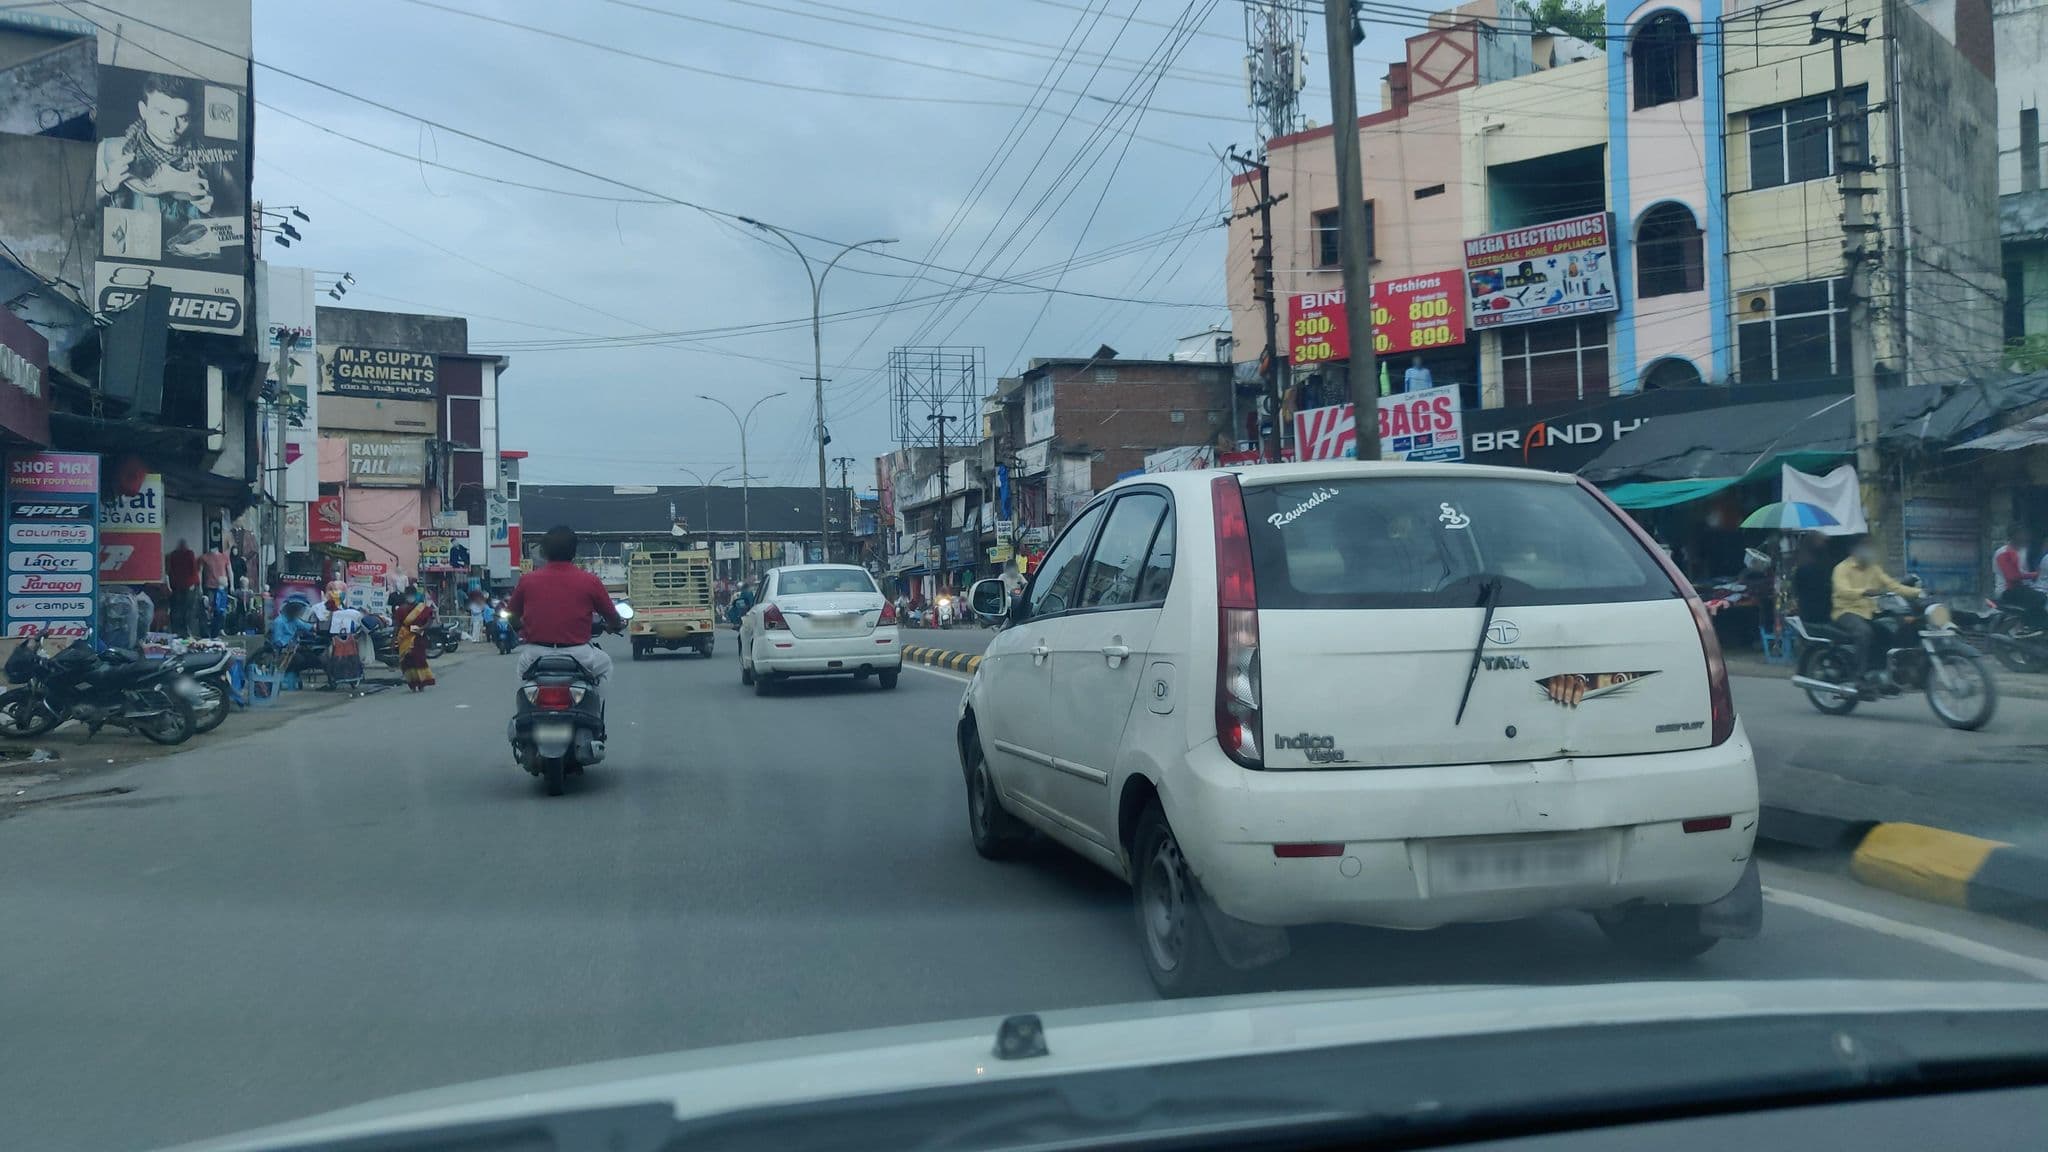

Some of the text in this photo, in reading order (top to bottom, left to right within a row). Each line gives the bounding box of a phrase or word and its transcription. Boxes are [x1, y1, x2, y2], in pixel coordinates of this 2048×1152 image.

[1466, 217, 1602, 256] MEGA ELECTRONICS
[1469, 237, 1603, 267] ELECTRICALS HOME APPLIANCES
[214, 287, 230, 295] USA
[1388, 277, 1440, 296] Fashions
[1409, 298, 1457, 321] 800/-
[1295, 317, 1336, 337] 300/-
[1410, 325, 1457, 347] 800/-
[340, 348, 434, 368] M.P. GUPTA
[1295, 342, 1337, 362] 300/-
[338, 363, 435, 383] GARMENTS
[1378, 396, 1453, 440] BAGS
[1472, 418, 1650, 465] BRAND H
[13, 461, 93, 475] SHOE MAX
[43, 478, 66, 486] FOOT
[16, 504, 88, 517] sparx
[17, 529, 87, 538] COLUMBUS
[24, 556, 78, 567] Lancer
[20, 574, 81, 592] Paragon
[35, 602, 85, 611] campus
[1480, 655, 1529, 670] TATA
[1275, 732, 1334, 750] Indica
[1304, 749, 1345, 762] Vista
